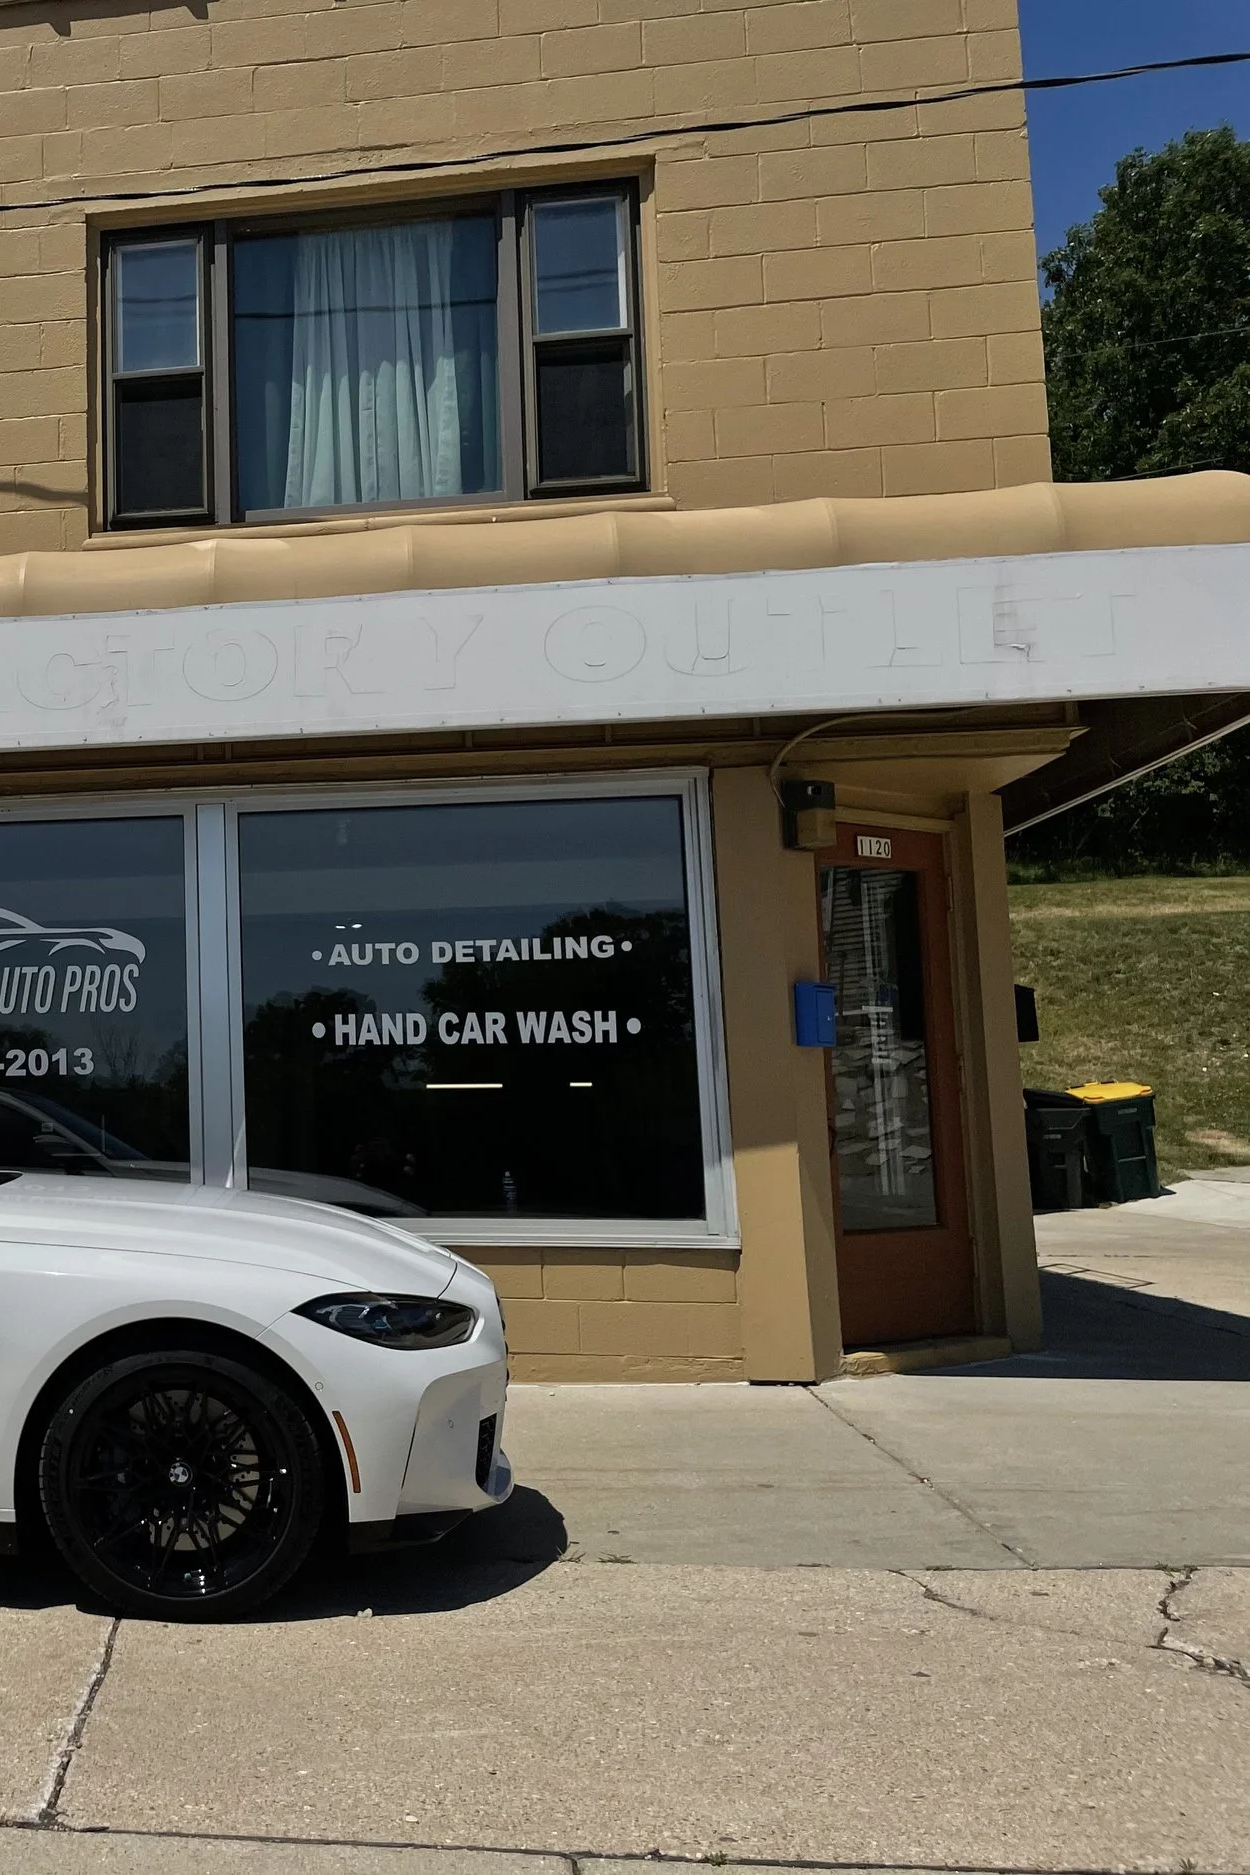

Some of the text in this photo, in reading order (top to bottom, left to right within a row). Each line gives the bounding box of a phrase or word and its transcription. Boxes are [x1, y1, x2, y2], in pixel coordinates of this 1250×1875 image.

[860, 838, 890, 858] 1120
[328, 935, 615, 966] AUTO DETAILING
[60, 963, 140, 1013] PROS
[334, 1010, 618, 1046] HAND CAR WASH
